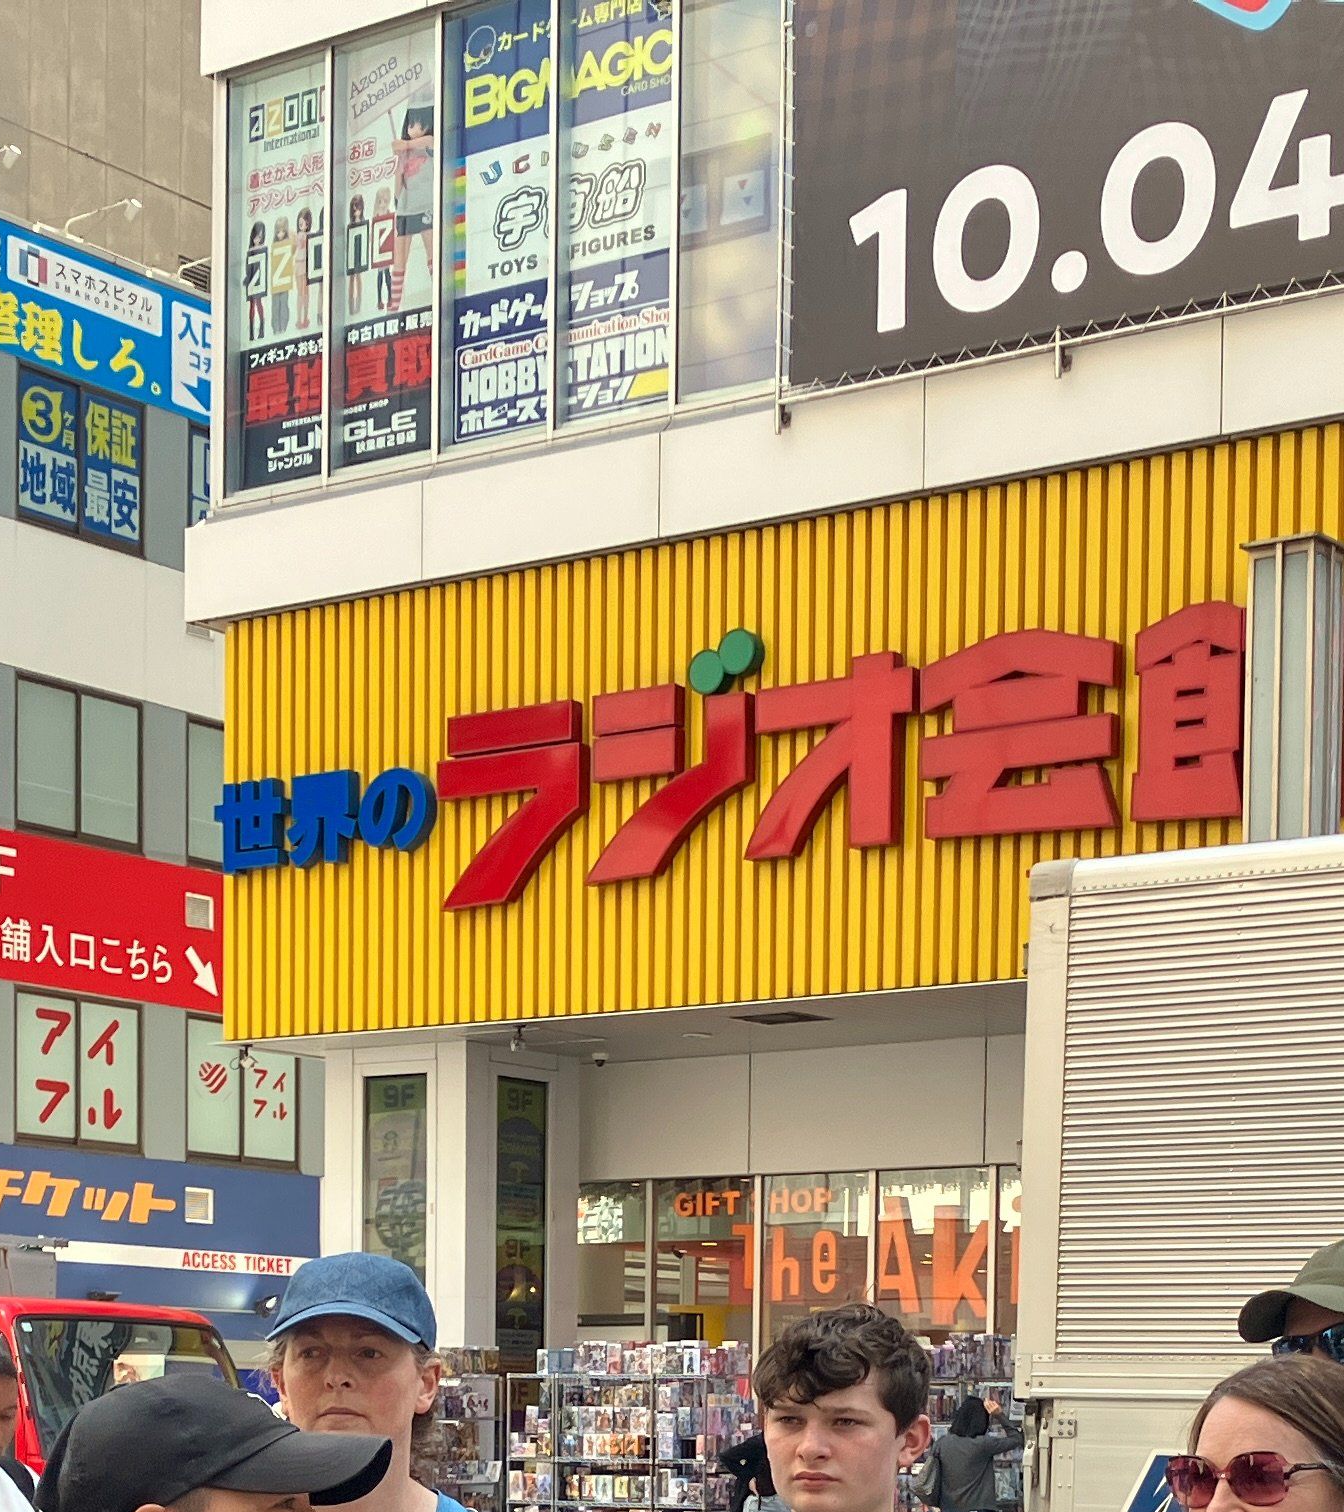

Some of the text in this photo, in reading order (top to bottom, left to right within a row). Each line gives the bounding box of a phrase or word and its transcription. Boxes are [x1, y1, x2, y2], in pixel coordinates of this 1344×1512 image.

[349, 55, 398, 100] Azone
[488, 224, 656, 280] TOYS FIGURES
[55, 262, 154, 313] スマホスピタル
[213, 767, 438, 876] 世界の
[673, 1190, 741, 1219] GIFT
[181, 1251, 293, 1276] ACCESS TICKET
[730, 1221, 838, 1303] The
